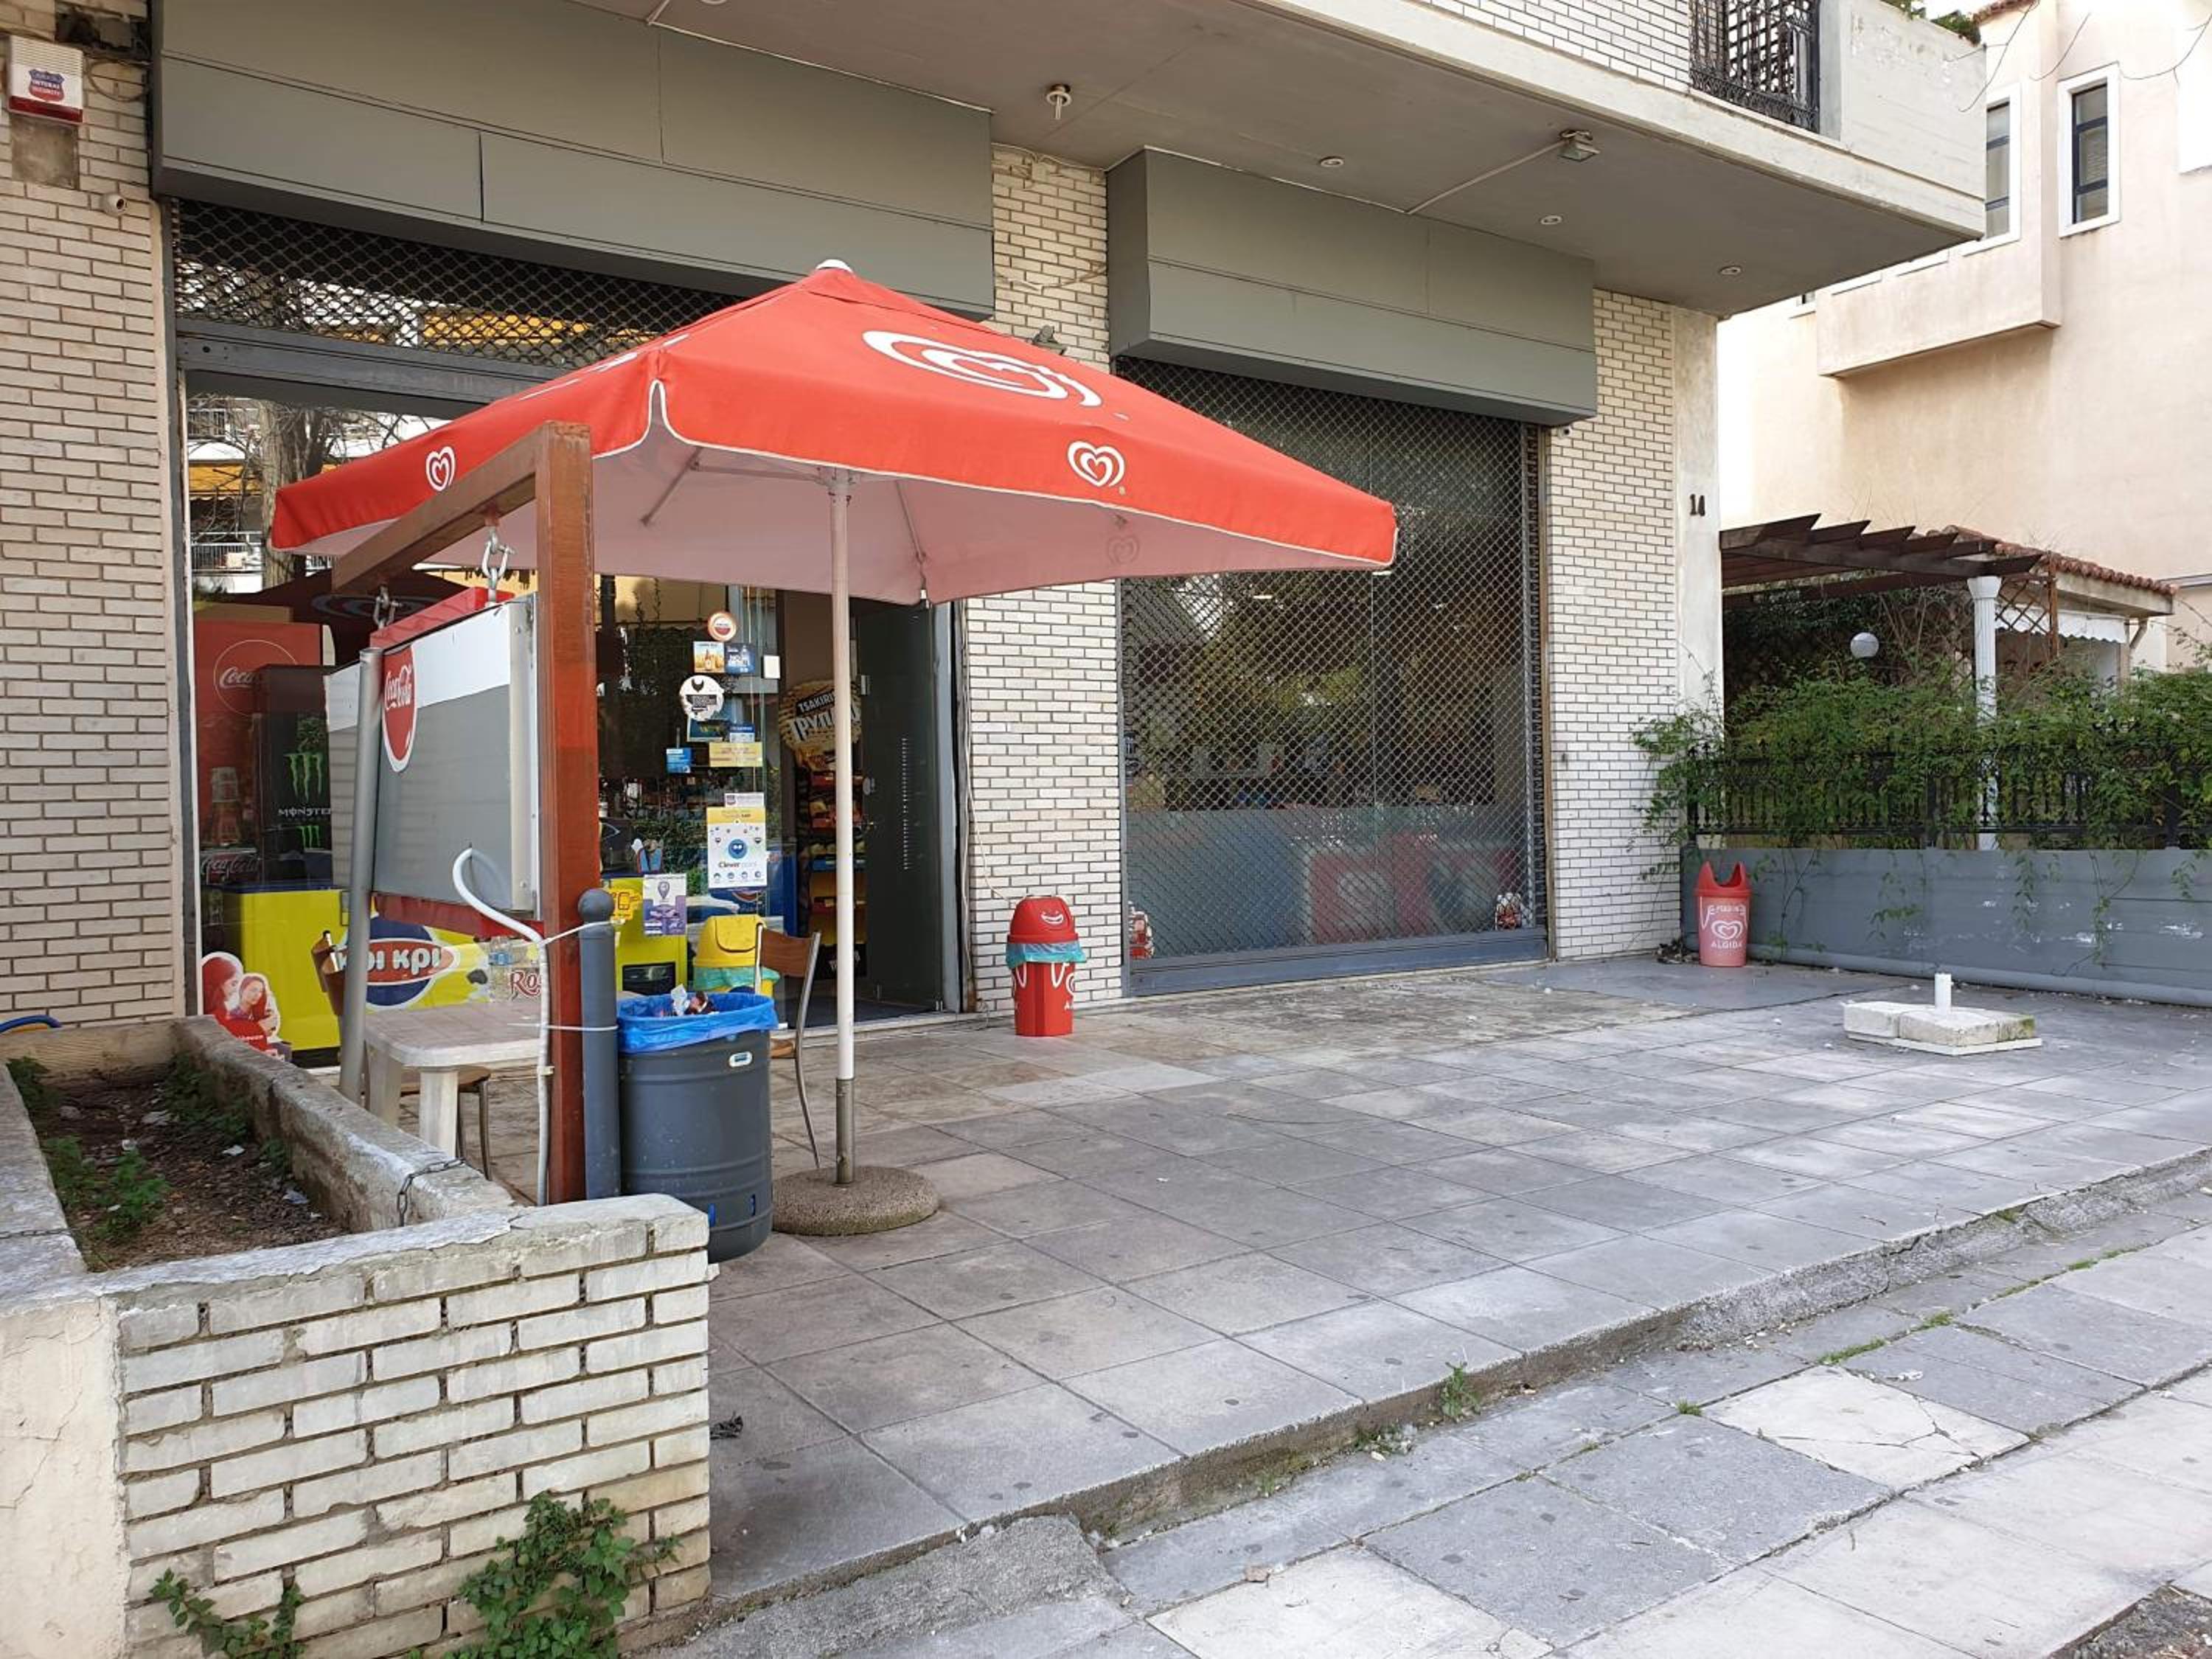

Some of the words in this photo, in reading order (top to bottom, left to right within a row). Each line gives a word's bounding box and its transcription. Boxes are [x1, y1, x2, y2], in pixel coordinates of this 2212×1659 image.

[798, 691, 835, 713] TSAKIRI
[277, 807, 331, 817] MONSTE
[1711, 940, 1742, 948] ALGIDA
